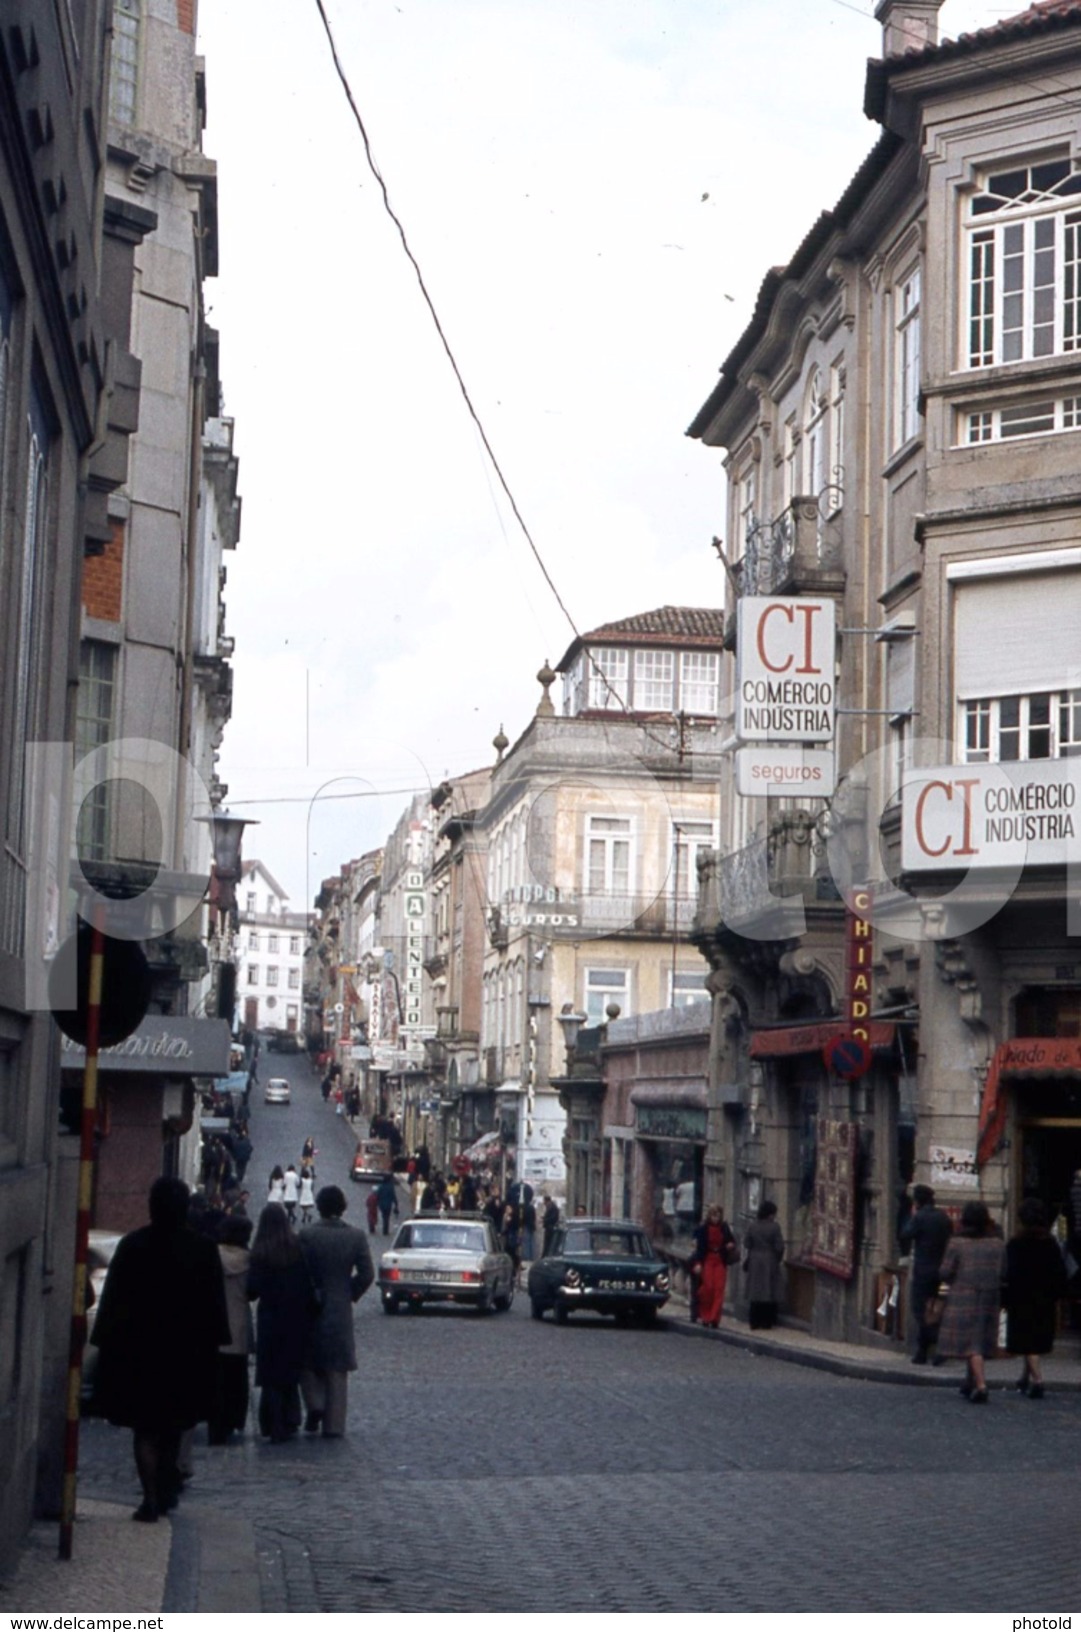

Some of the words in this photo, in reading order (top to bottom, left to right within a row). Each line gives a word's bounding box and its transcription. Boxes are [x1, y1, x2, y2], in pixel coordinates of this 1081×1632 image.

[756, 603, 822, 674] CI
[743, 679, 832, 705] COMÉRCIO
[743, 706, 832, 732] INDÚSTRIA
[751, 762, 822, 784] seguros
[984, 782, 1076, 813] COMÉRCIO
[915, 778, 981, 857] CI
[984, 809, 1075, 843] INDÚSTRIA
[407, 897, 423, 1023] ALENTEJO
